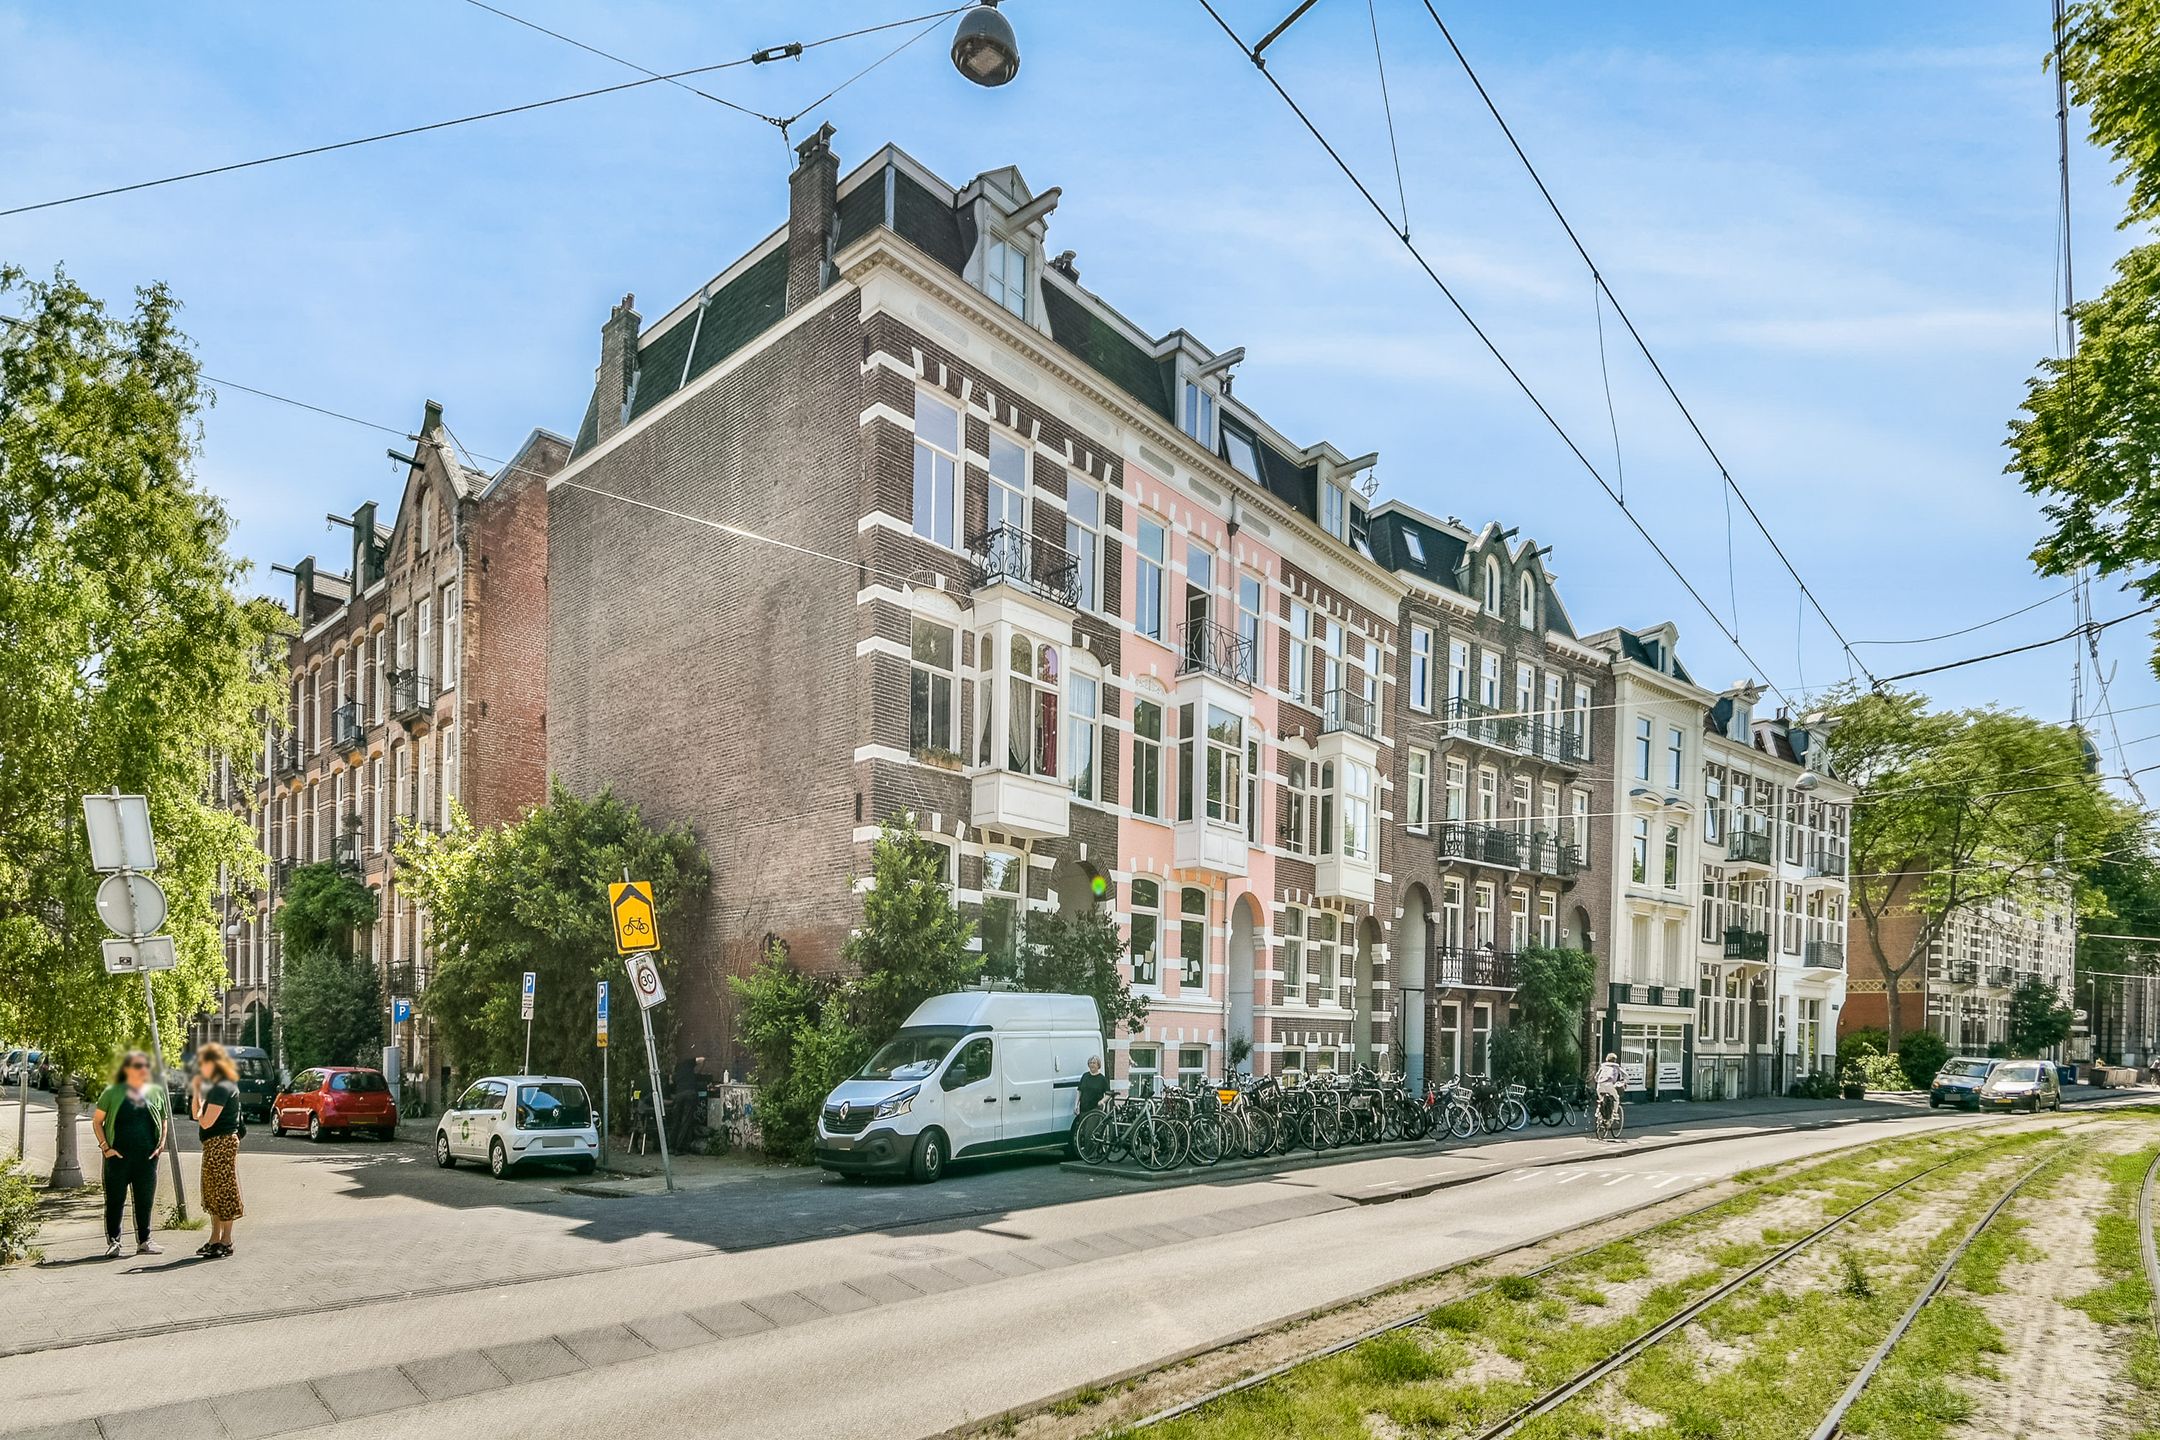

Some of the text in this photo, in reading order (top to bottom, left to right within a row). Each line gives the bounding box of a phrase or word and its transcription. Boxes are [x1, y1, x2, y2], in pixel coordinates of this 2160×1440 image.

[525, 975, 533, 993] P
[640, 973, 653, 987] 30
[599, 985, 605, 1005] P
[399, 1006, 406, 1016] P
